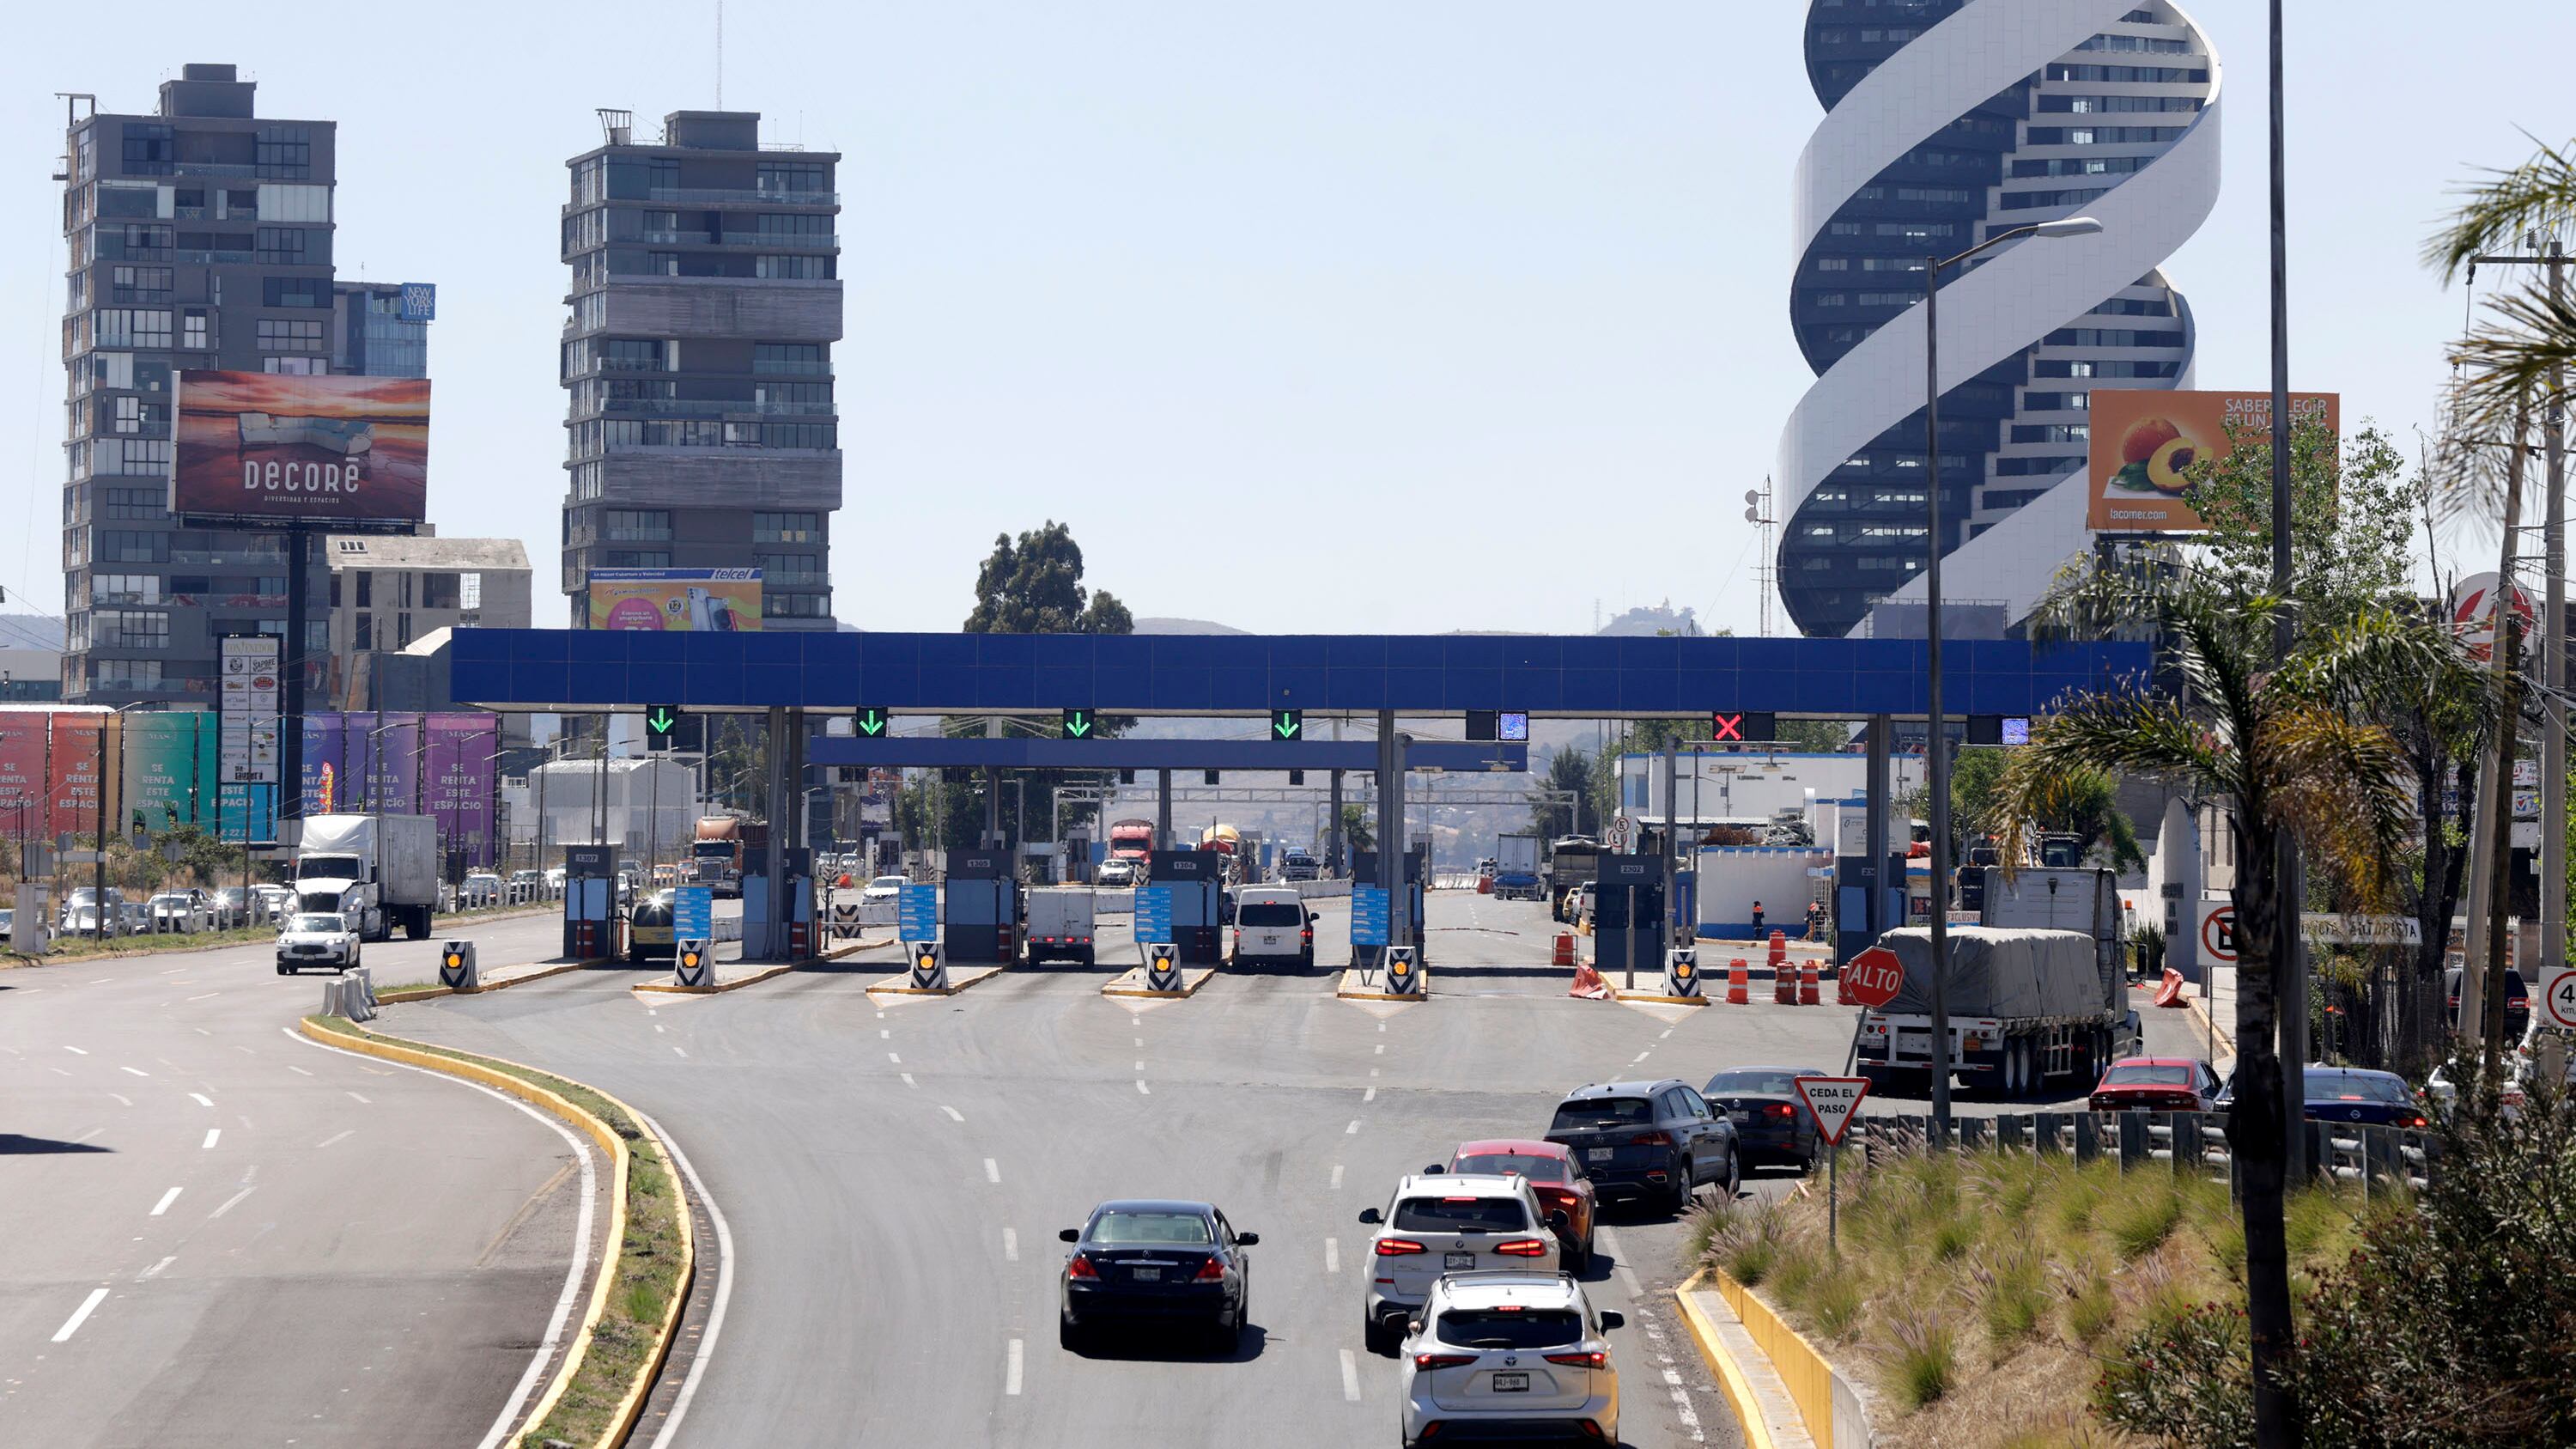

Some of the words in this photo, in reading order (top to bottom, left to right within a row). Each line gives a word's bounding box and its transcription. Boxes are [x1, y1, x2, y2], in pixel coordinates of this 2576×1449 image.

[408, 287, 431, 296] NEW
[404, 295, 434, 306] YORK
[409, 305, 430, 315] LIFE
[2226, 399, 2272, 412] SABER
[2245, 414, 2266, 426] UN
[2110, 508, 2167, 521] lacomer.com
[715, 569, 749, 580] telcel
[151, 764, 163, 772] SE
[452, 764, 464, 772] SE
[147, 788, 169, 796] ESTE
[222, 786, 244, 795] ESTE
[59, 800, 99, 808] ESPACI
[434, 801, 481, 809] ESPACIO
[1947, 912, 1980, 922] EXCLUSIVO
[1849, 963, 1899, 992] ALTO
[1809, 1087, 1838, 1098] CEDA
[1842, 1088, 1856, 1098] EL
[1818, 1105, 1846, 1114] PASO
